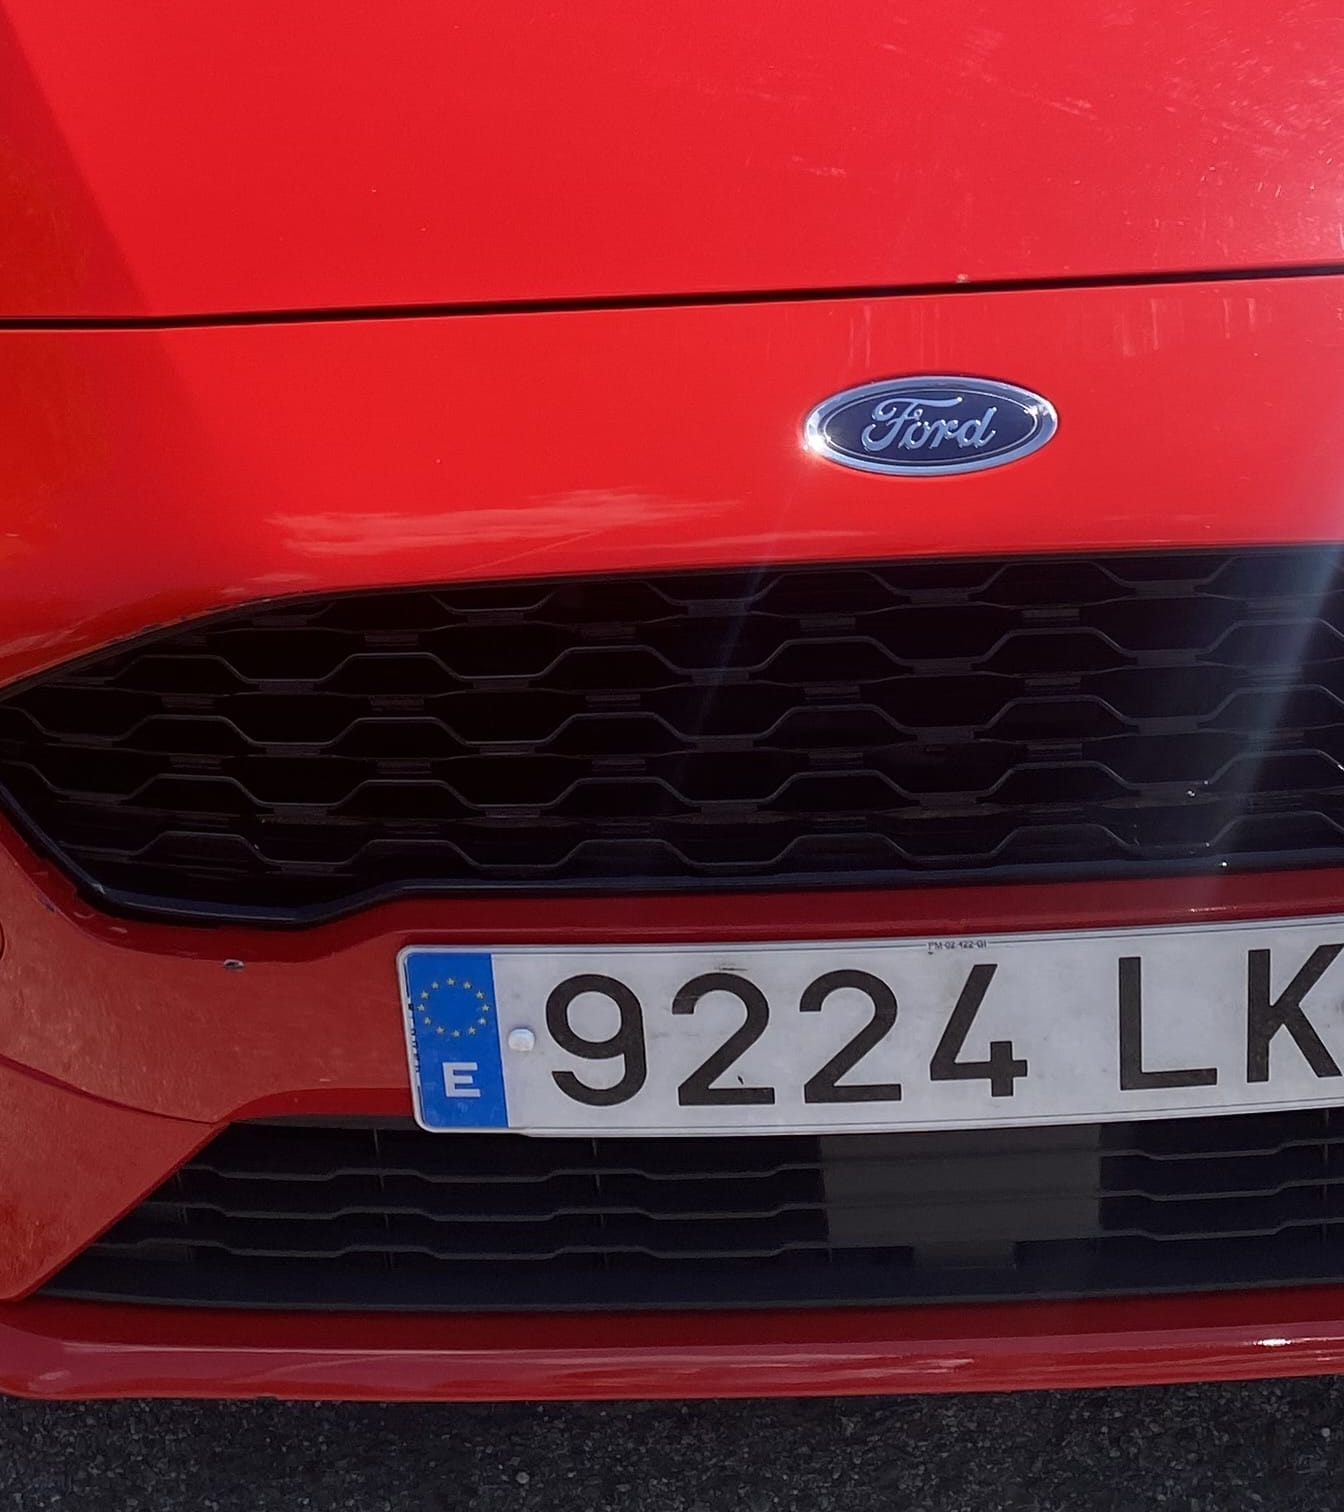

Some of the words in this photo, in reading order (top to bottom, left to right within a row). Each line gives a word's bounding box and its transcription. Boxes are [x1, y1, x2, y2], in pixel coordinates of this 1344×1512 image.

[861, 396, 997, 452] Ford
[545, 963, 1028, 1106] 9224
[442, 1061, 481, 1098] E
